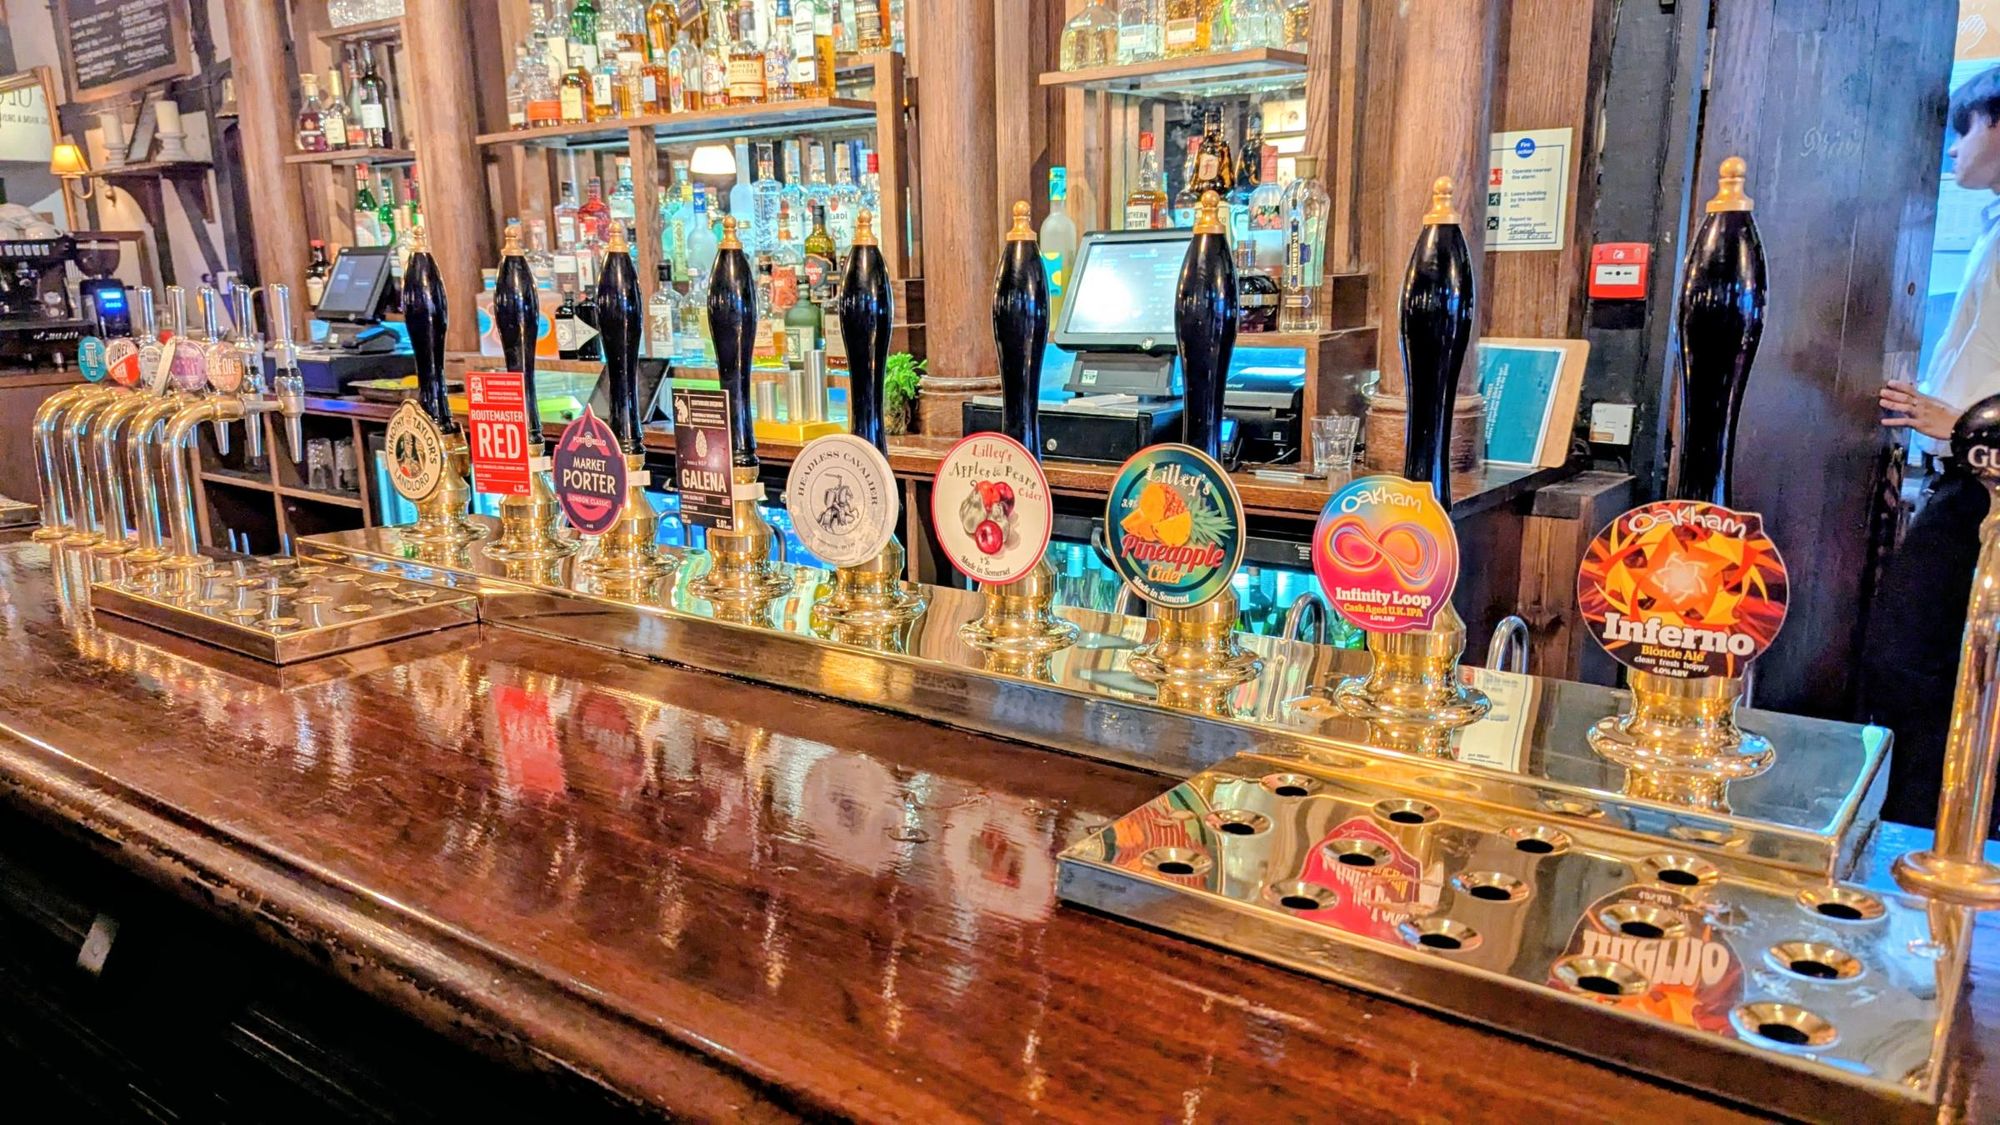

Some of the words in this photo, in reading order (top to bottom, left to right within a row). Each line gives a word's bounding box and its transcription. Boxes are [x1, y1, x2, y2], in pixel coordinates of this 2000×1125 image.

[470, 409, 524, 422] ROUTEMASTER
[388, 416, 404, 456] TIMOTHY
[412, 416, 438, 465] TAYLOR'S
[477, 422, 521, 459] RED
[572, 457, 606, 472] MARKET
[971, 444, 1013, 464] Lilley's
[394, 469, 430, 492] LANDLORD
[563, 469, 616, 495] PORTER
[681, 468, 727, 493] GALENA
[798, 450, 840, 497] HEADLESS
[843, 452, 878, 506] CAVALIER
[949, 461, 991, 479] Apples
[992, 467, 1001, 477] &
[1005, 465, 1037, 490] Pears
[1144, 462, 1213, 497] Lilley's
[569, 494, 589, 504] LONDON
[590, 498, 609, 507] CLASSIC
[1018, 487, 1043, 502] Cider
[1341, 486, 1422, 513] Oakham
[1628, 506, 1747, 539] Oakham
[960, 554, 976, 571] Made
[984, 566, 1011, 577] Somerset
[1121, 534, 1225, 573] Pineapple
[1147, 564, 1185, 584] Cider
[1132, 575, 1150, 595] Made
[1150, 588, 1159, 599] in
[1159, 590, 1190, 604] Somerset
[1335, 587, 1391, 605] Infinity
[1392, 591, 1431, 609] Loop
[1343, 603, 1364, 613] Cask
[1365, 605, 1388, 615] Aged
[1388, 607, 1406, 616] U.K.
[1406, 608, 1424, 618] IPA
[1602, 612, 1756, 657] Inferno
[1634, 655, 1656, 665] clean
[1659, 655, 1680, 667] fresh
[1683, 657, 1710, 673] hoppy
[1641, 645, 1683, 661] Blonde
[1684, 650, 1706, 662] Ale
